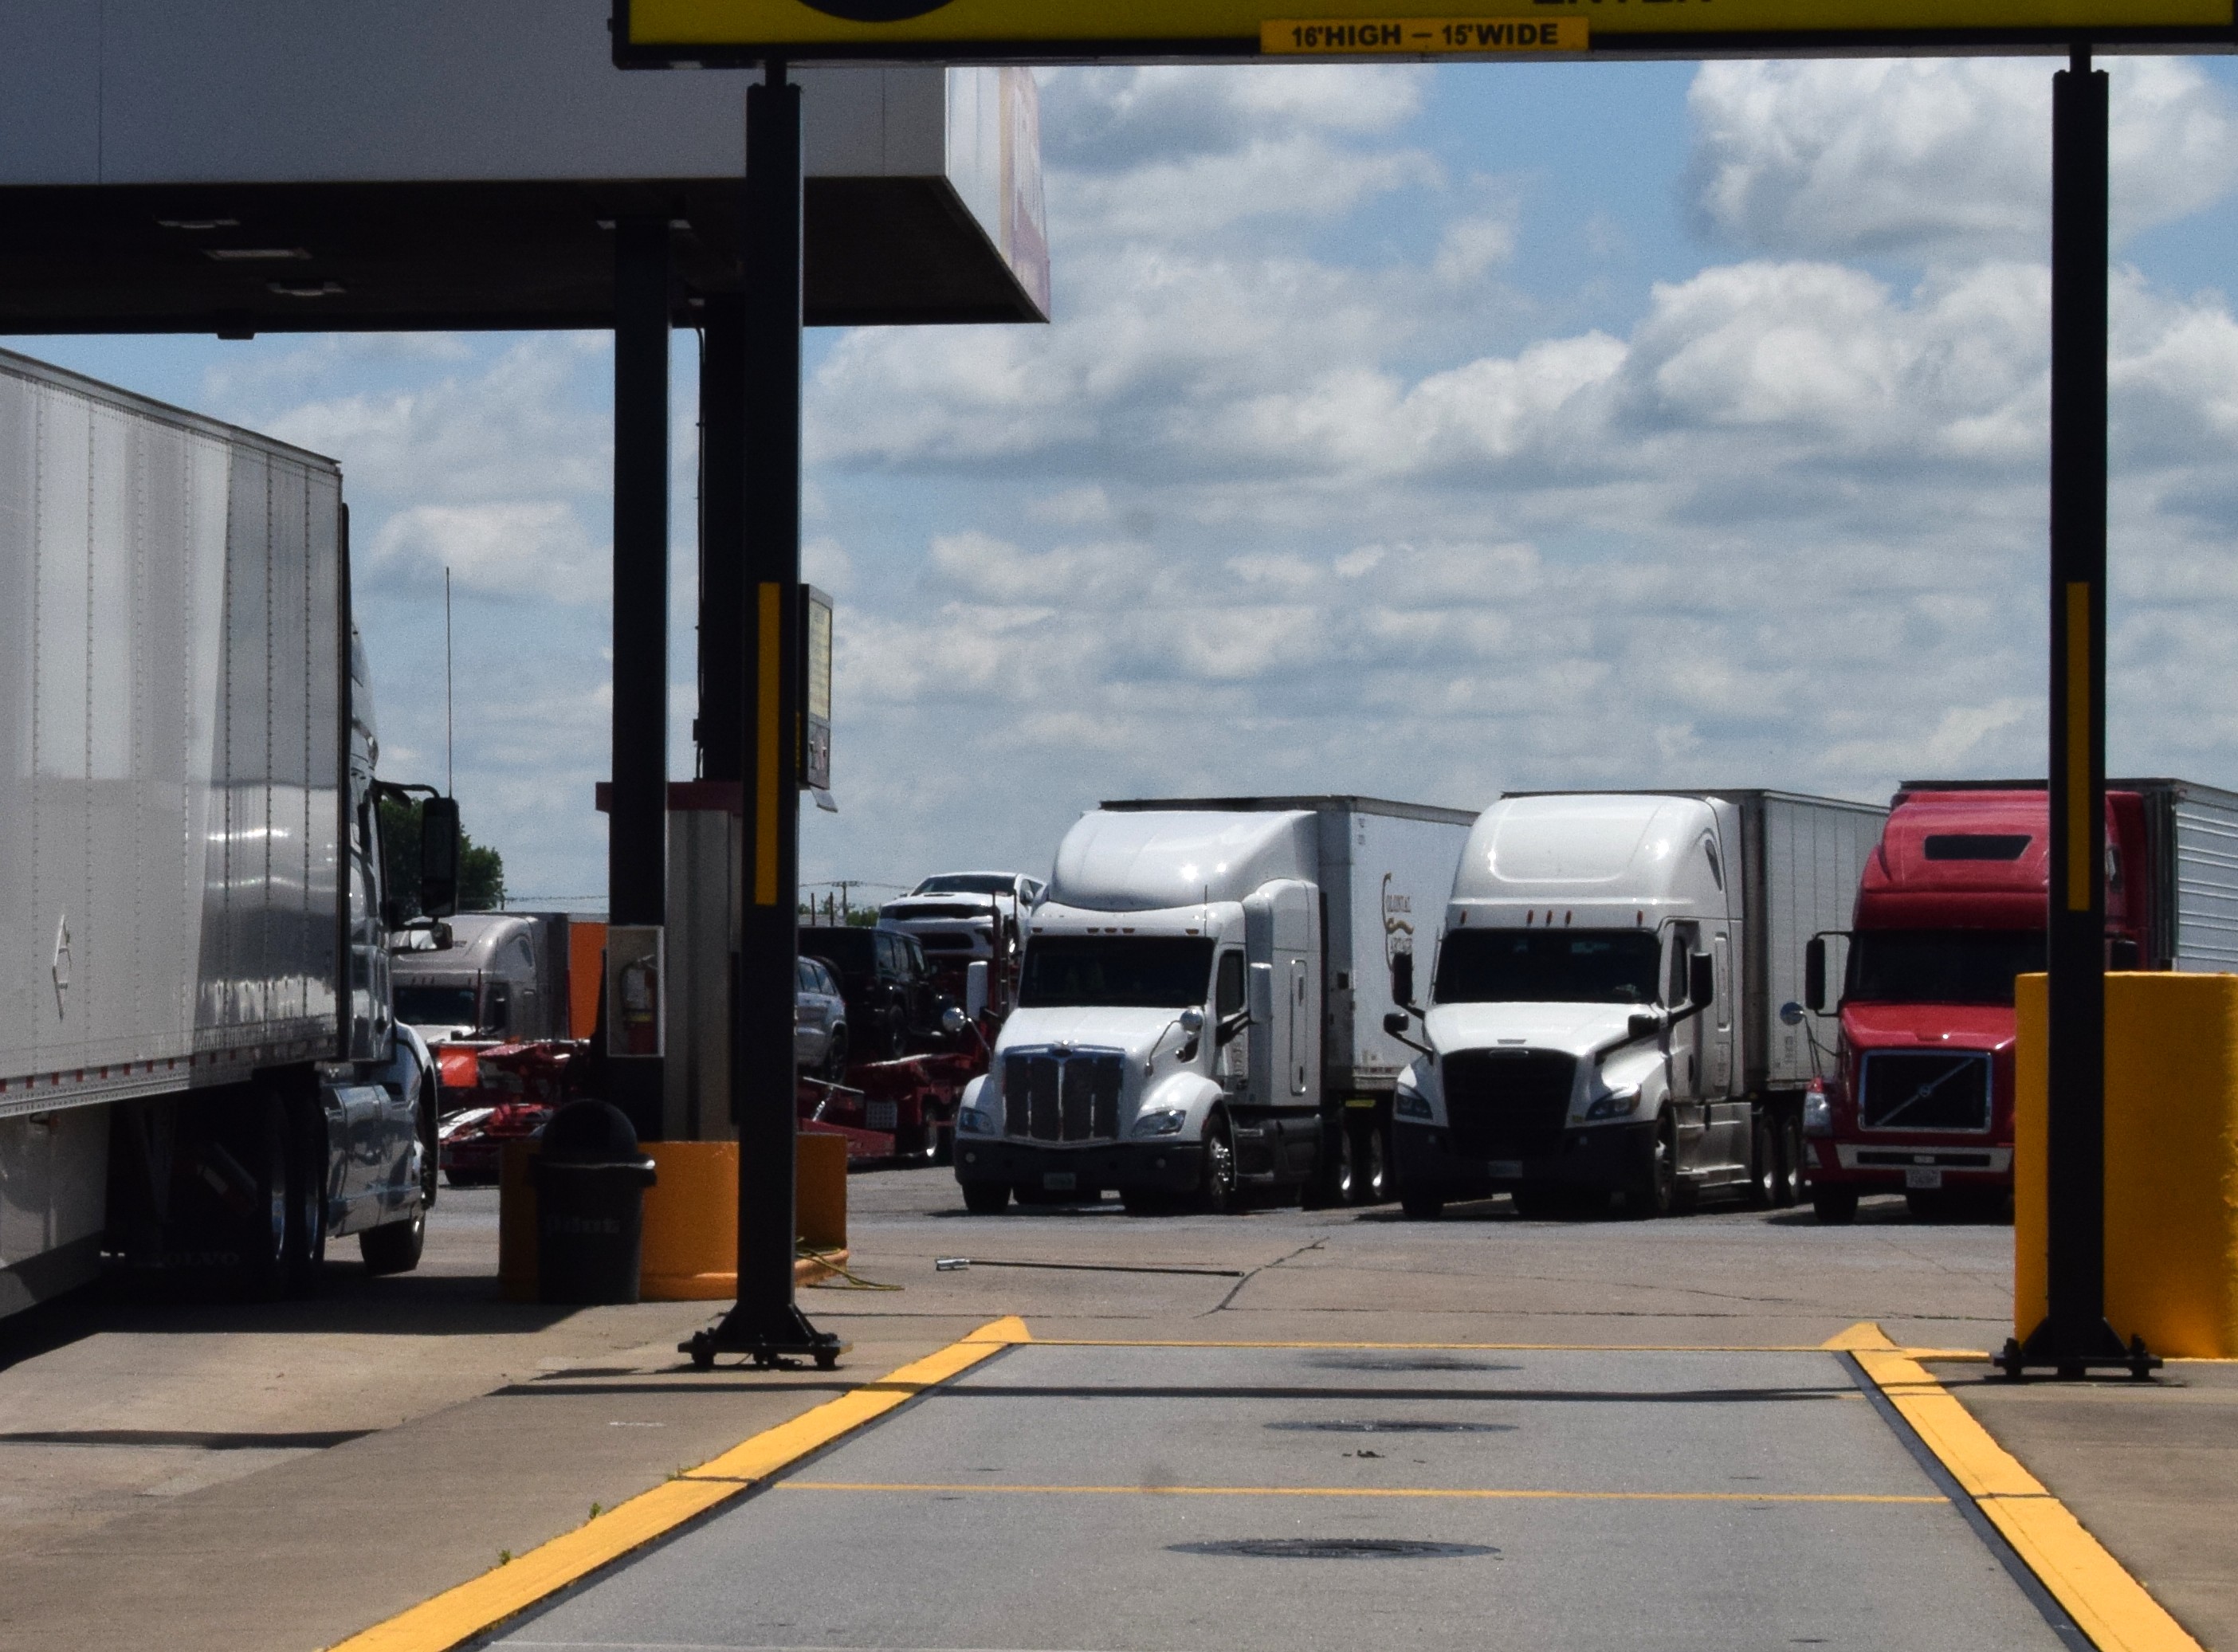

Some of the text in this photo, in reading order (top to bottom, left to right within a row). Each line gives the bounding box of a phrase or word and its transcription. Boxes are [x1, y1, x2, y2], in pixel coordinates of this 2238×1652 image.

[1292, 25, 1401, 47] 16'HIGH
[1442, 23, 1558, 45] 15'WIDE
[150, 1251, 240, 1267] OLVO
